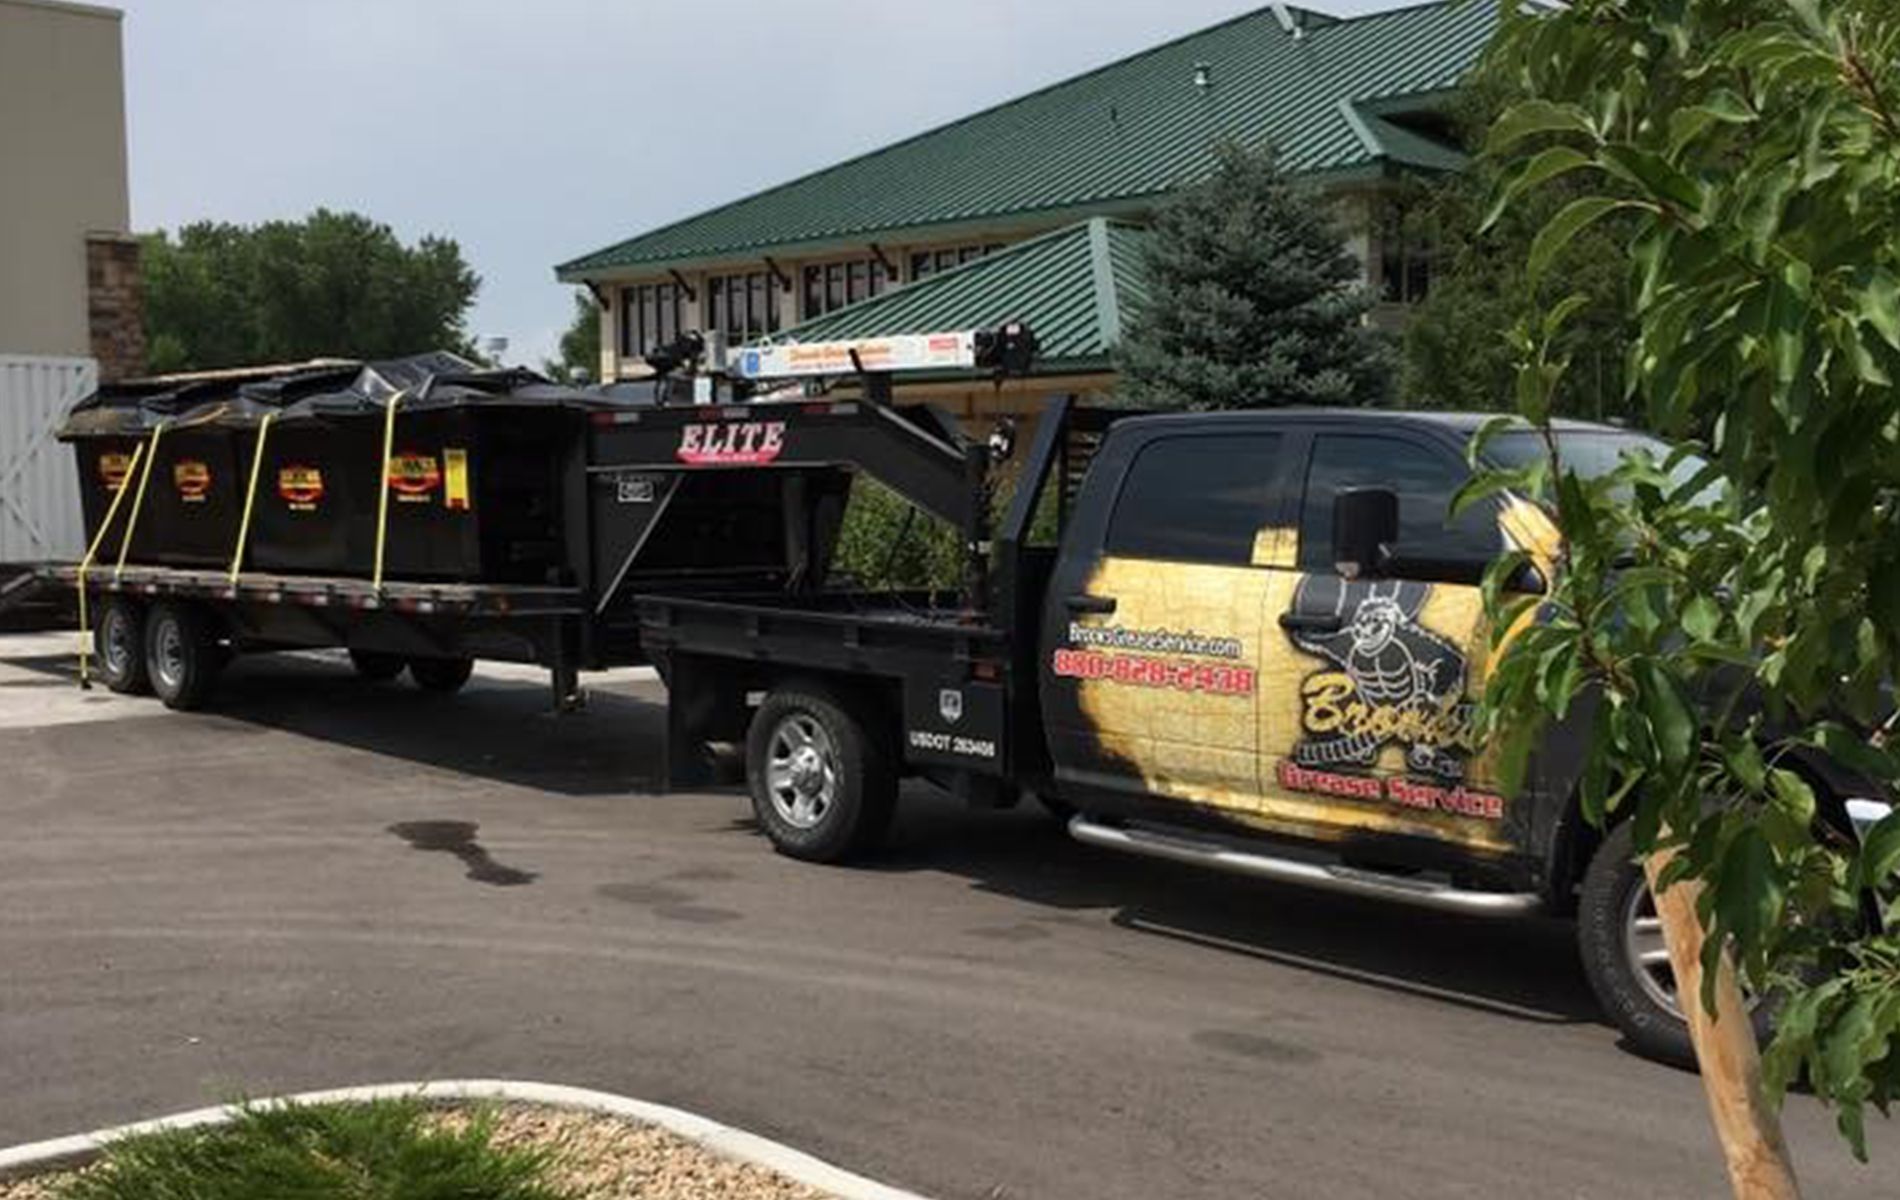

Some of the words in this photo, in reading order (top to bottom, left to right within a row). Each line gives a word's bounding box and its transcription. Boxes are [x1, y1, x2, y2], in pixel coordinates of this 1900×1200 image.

[677, 421, 785, 455] ELITE
[909, 731, 951, 751] USDOT
[1280, 761, 1382, 799] Grease
[1387, 776, 1503, 819] Service
